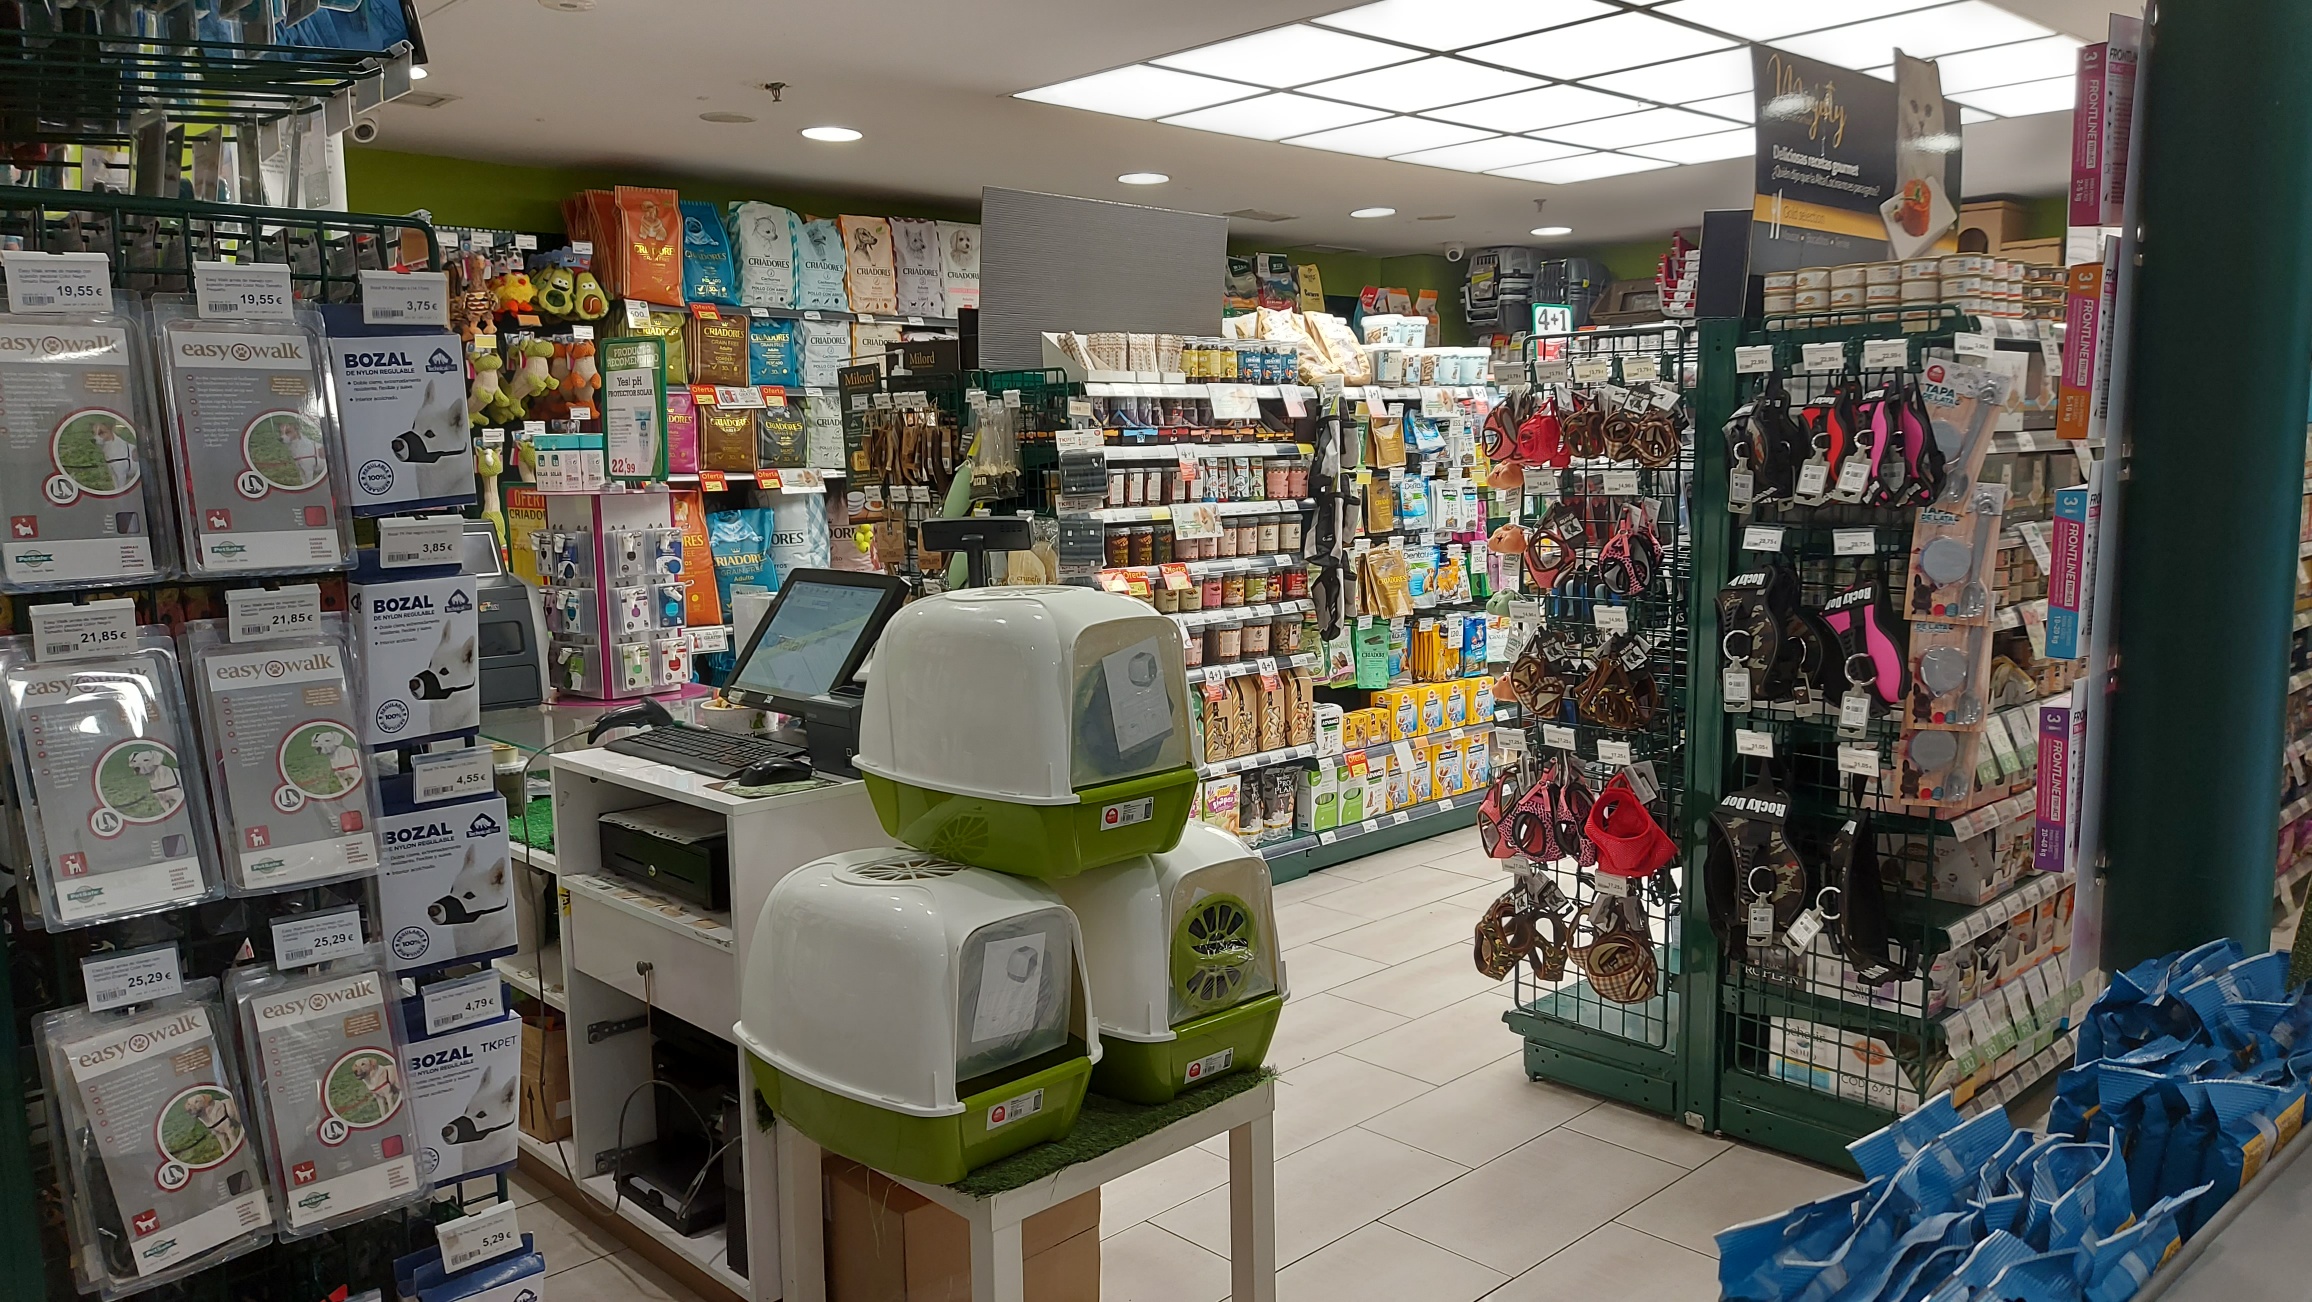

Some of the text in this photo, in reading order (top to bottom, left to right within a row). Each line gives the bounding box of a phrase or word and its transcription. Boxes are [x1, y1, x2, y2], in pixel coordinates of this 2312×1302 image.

[2084, 52, 2098, 62] 3
[2109, 47, 2138, 62] FRONTLIN
[2088, 79, 2099, 140] FRONTLINE
[1773, 144, 1808, 166] Deliciosas
[1808, 156, 1832, 171] recetas
[2086, 142, 2096, 168] TRI-ACT
[2074, 192, 2082, 202] kg
[748, 258, 790, 269] CRIADORES
[805, 261, 844, 272] CRIADORES
[856, 267, 891, 277] CRIADORES
[902, 267, 939, 277] CRIADORES
[2078, 272, 2093, 282] 3
[1537, 308, 1567, 331] 4+1
[704, 327, 745, 338] CRIADORES
[2080, 299, 2094, 359] FRONTLINE
[750, 333, 790, 342] CRIADORES
[810, 336, 846, 345] CRIADORES
[181, 342, 303, 360] easy walk
[344, 352, 413, 368] BOZAL
[909, 351, 935, 365] Milord
[380, 367, 415, 375] REGULABLE
[2077, 359, 2088, 386] TRI-ACT
[617, 376, 642, 388] Yes! pH
[844, 371, 875, 387] Milord
[608, 389, 637, 398] PROTECTOR
[1925, 383, 1955, 397] TAPA
[1935, 394, 1955, 404] LATA
[2063, 412, 2071, 422] kg
[701, 472, 724, 480] Oferta
[2064, 496, 2078, 506] 3
[1933, 514, 1953, 522] LATA
[1163, 565, 1186, 574] Oferta
[2064, 522, 2079, 607] FRONTLINE TRI-ACT
[720, 568, 744, 576] GRAIN
[1123, 571, 1146, 579] Oferta
[1843, 586, 1872, 606] Rocky
[373, 595, 434, 613] BOZAL
[404, 610, 435, 618] REGULABLE
[1564, 632, 1575, 643] XS
[1583, 632, 1593, 644] XS
[2051, 635, 2059, 645] kg
[216, 654, 335, 680] easy walk
[1261, 660, 1275, 671] 4+1
[1208, 670, 1223, 681] 4+1
[26, 678, 75, 697] easy
[2047, 714, 2062, 724] 3
[1278, 779, 1292, 788] PRO
[2050, 739, 2063, 821] FRONTLINE TRI-ACT
[1274, 785, 1294, 794] PLAN
[1721, 796, 1786, 817] Rocky Dog
[383, 822, 453, 845] BOZAL
[394, 836, 455, 850] NYLON REGULABLE
[2039, 848, 2046, 858] kg
[402, 939, 421, 947] 100%
[262, 981, 375, 1019] easy walk
[79, 1014, 202, 1068] easy walk
[481, 1035, 517, 1053] TKPET
[417, 1059, 474, 1076] NYLON REGULABLE
[1841, 1074, 1892, 1096] COD 673
